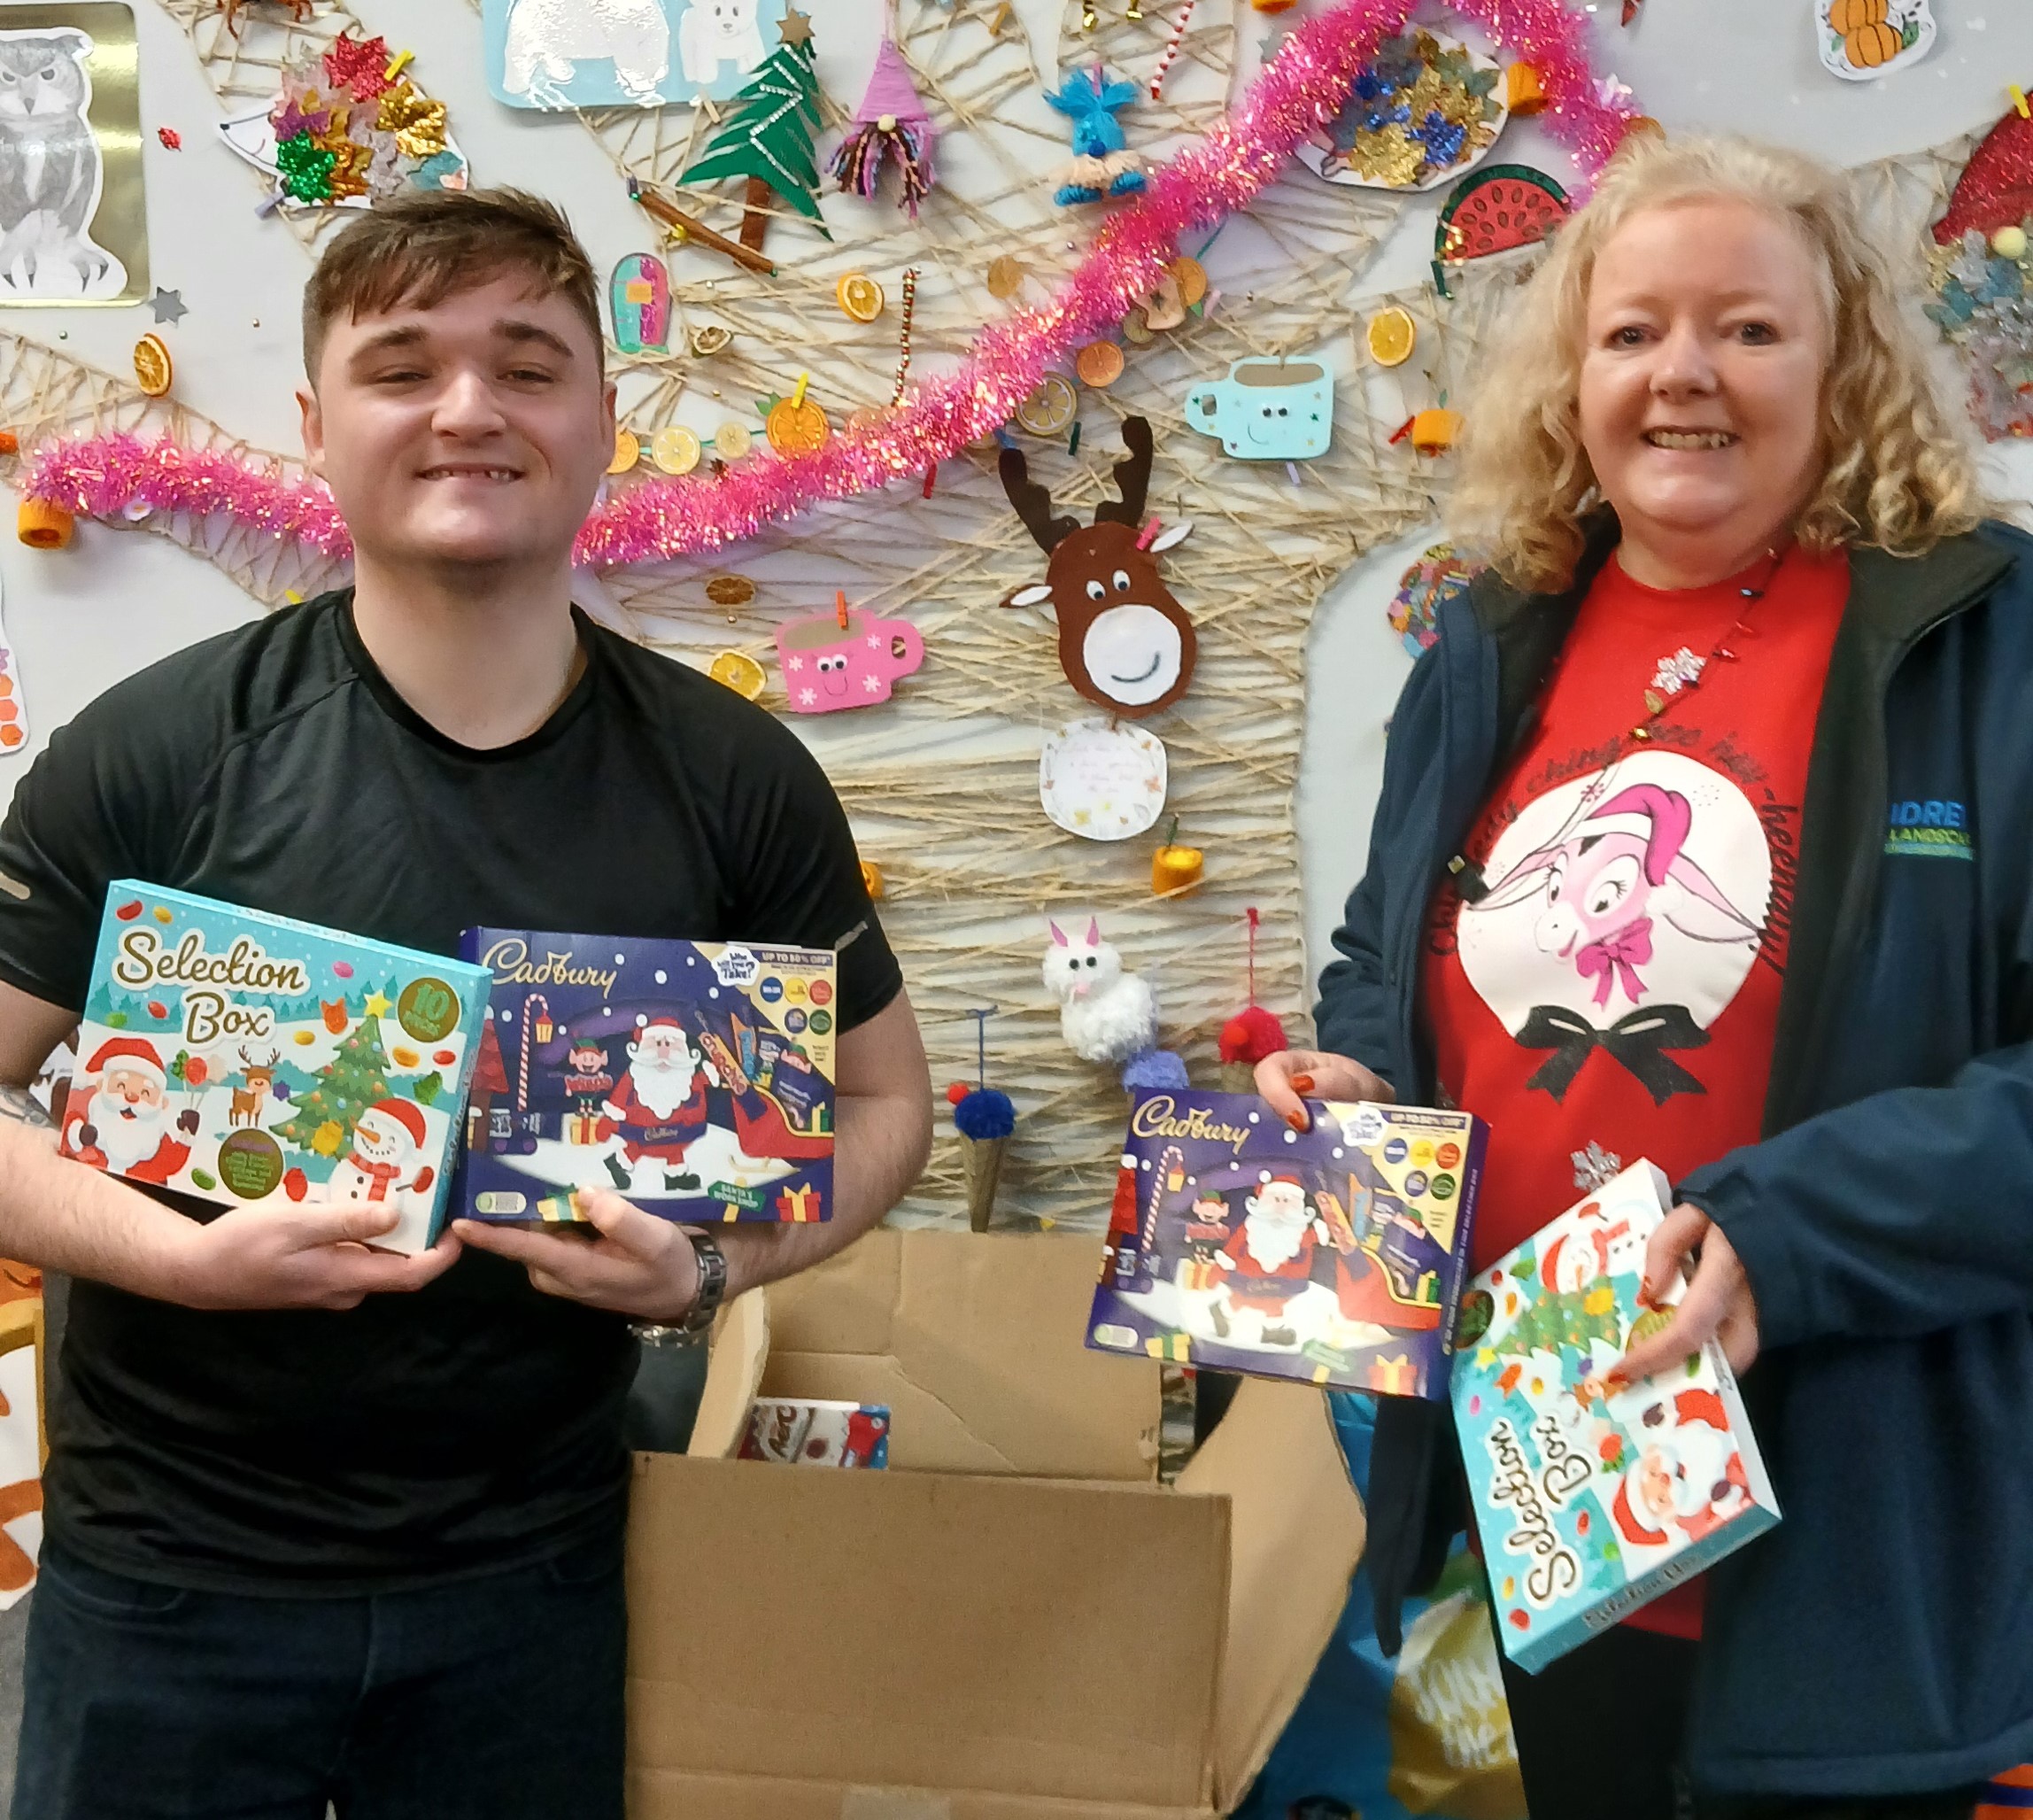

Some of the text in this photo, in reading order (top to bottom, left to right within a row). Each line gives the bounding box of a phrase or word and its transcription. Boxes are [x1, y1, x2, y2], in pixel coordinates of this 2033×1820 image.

[117, 931, 304, 990] Selection
[482, 938, 617, 999] Cadbury
[186, 992, 268, 1044] Box
[1132, 1095, 1251, 1155] Cadbury
[1535, 1415, 1592, 1506] Box
[1490, 1421, 1576, 1601] Selection
